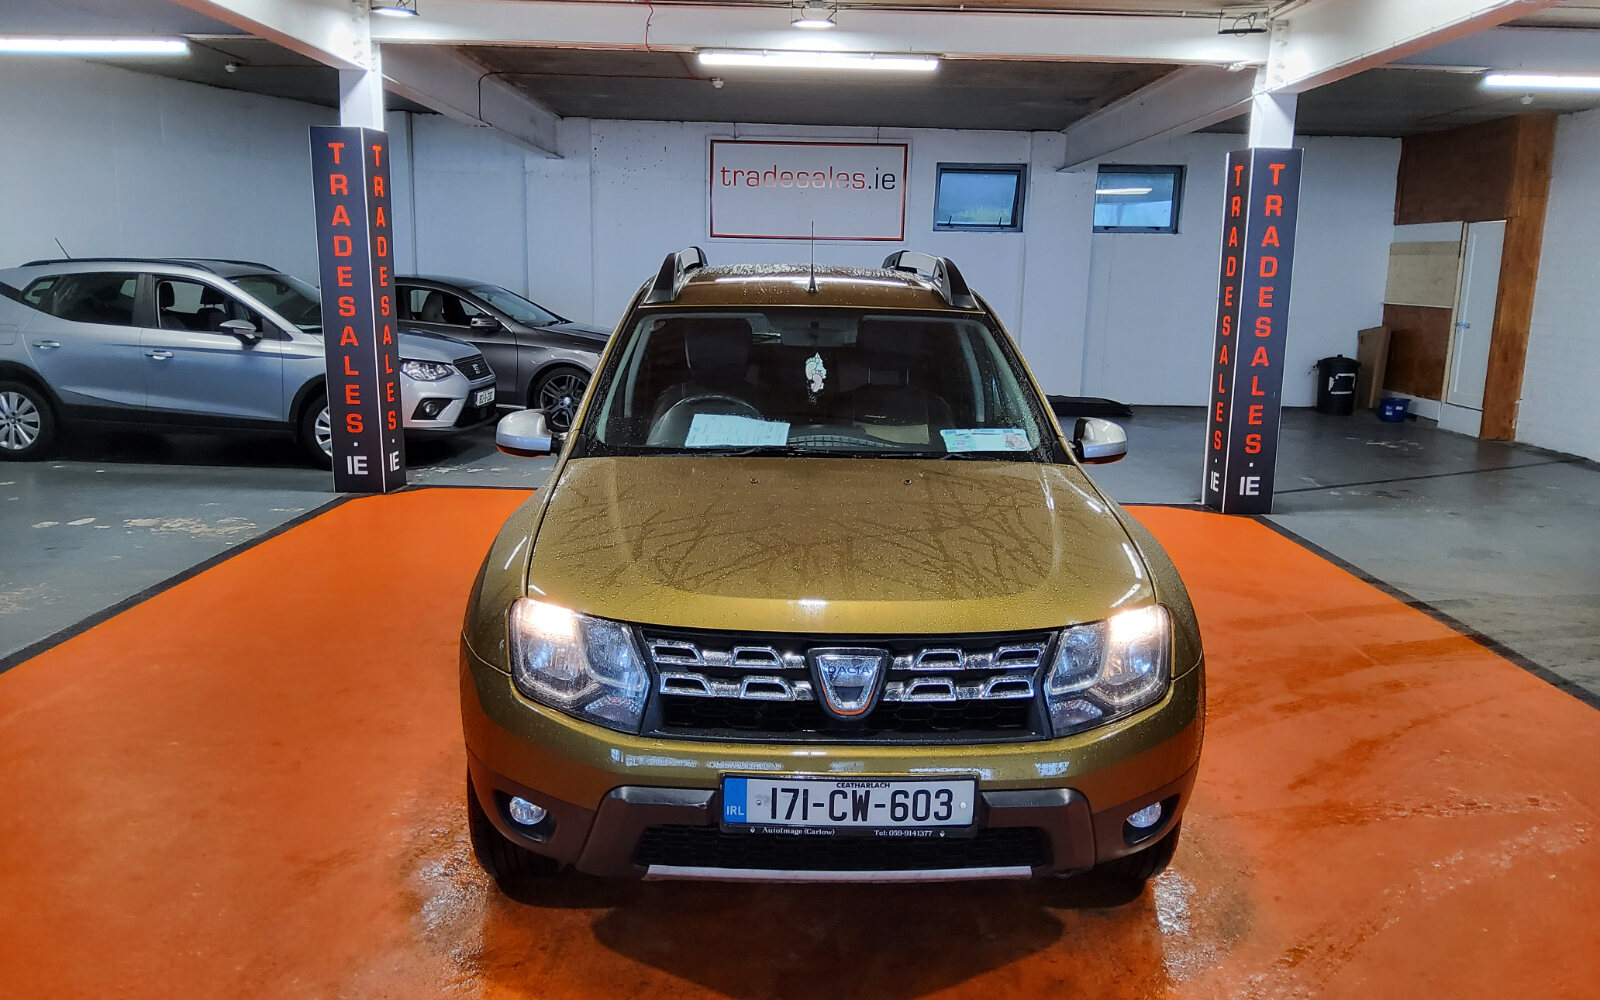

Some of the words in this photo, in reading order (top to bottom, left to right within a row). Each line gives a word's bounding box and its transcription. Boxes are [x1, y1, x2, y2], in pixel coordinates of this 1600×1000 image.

[720, 164, 896, 190] tradesales.ie
[328, 142, 369, 476] TRADESALES.IE
[372, 144, 400, 473] TRADESALES.IE
[1210, 165, 1244, 494] TRADESALES.IE
[1238, 163, 1286, 497] TRADESALES.IE
[726, 805, 745, 817] IRL
[770, 788, 954, 822] 171-CW-603
[762, 827, 803, 836] AutoImage
[804, 828, 836, 837] (Carlow)
[874, 829, 888, 837] Tel:
